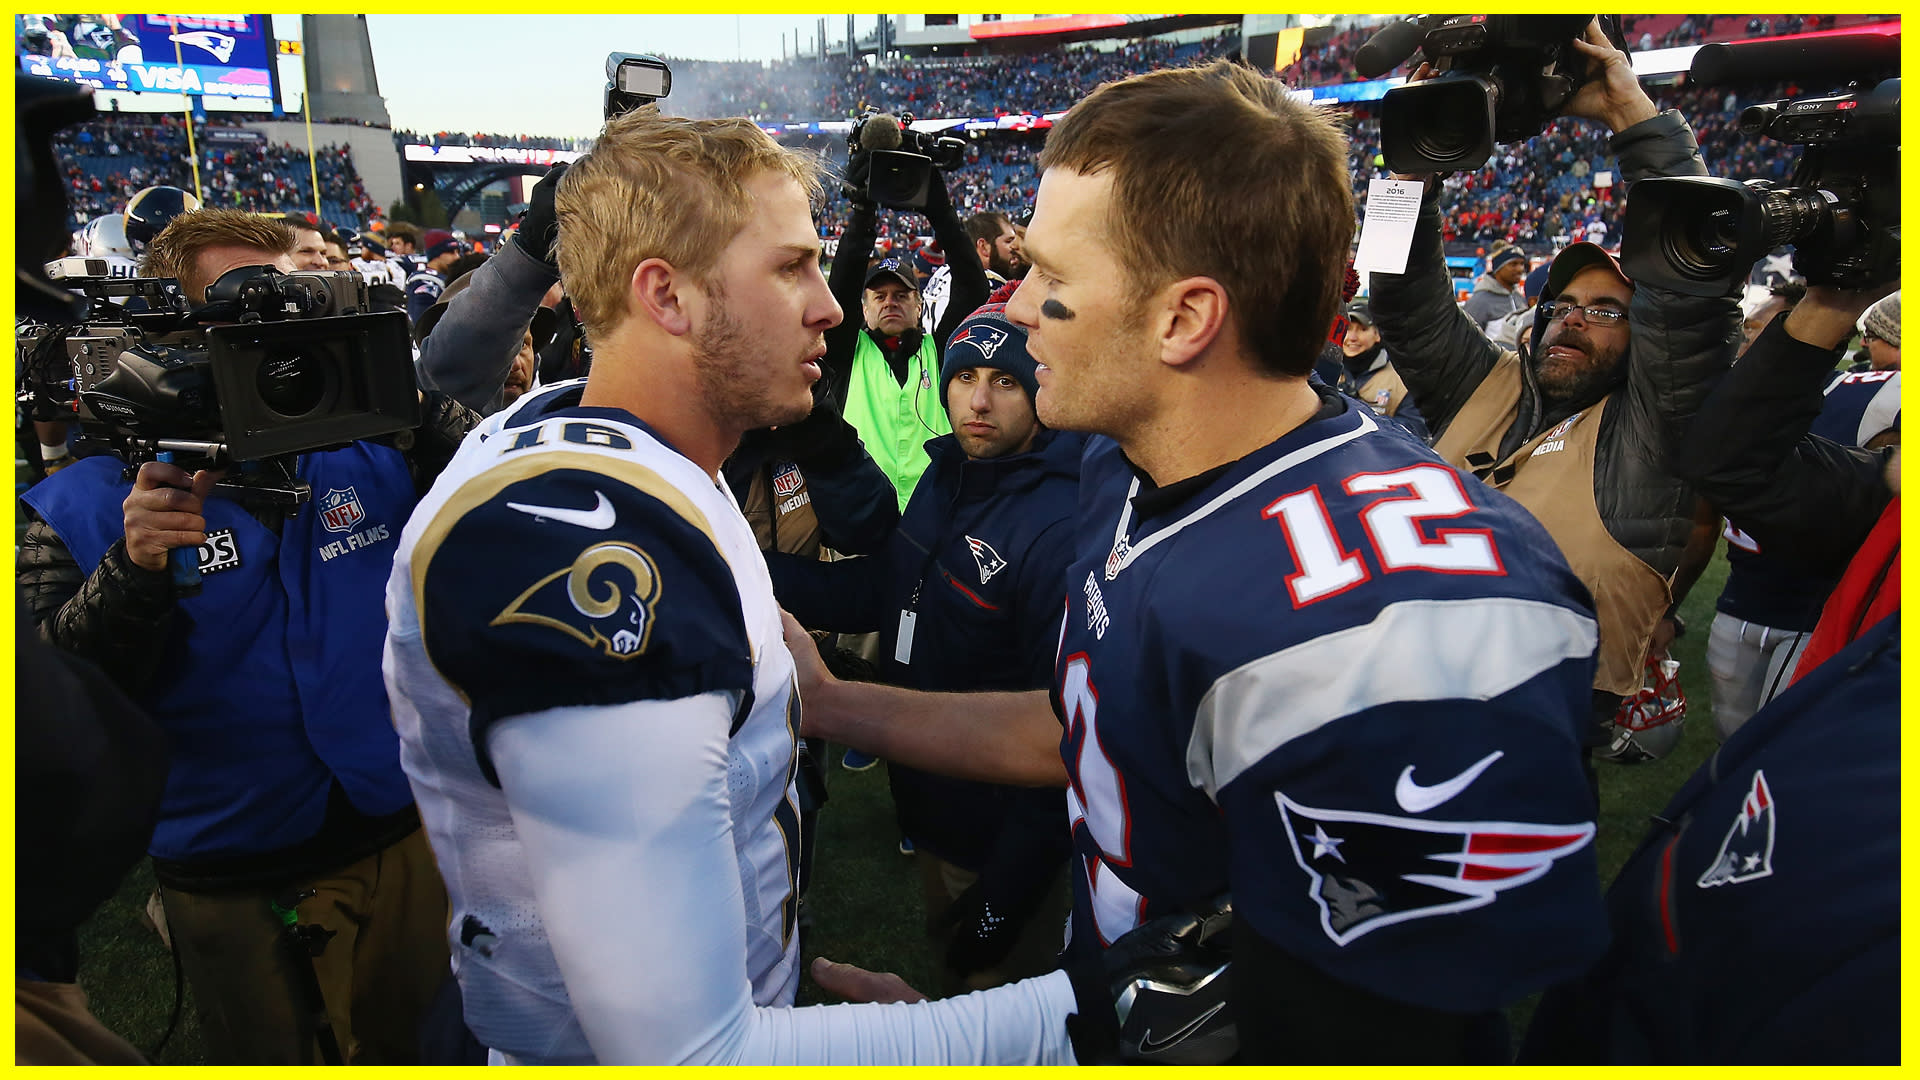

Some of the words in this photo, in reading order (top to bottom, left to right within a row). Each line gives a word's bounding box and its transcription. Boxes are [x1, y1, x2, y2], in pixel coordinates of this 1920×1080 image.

[131, 65, 202, 91] VISA
[1796, 103, 1822, 111] SONY
[1386, 187, 1405, 195] 2016
[498, 422, 636, 457] 16
[774, 471, 800, 492] NFL
[324, 503, 361, 529] NFL
[778, 491, 811, 516] MEDIA
[318, 540, 349, 562] NFL
[349, 523, 390, 551] FILMS
[1260, 462, 1508, 610] 12
[1083, 570, 1110, 640] PATRIOTS
